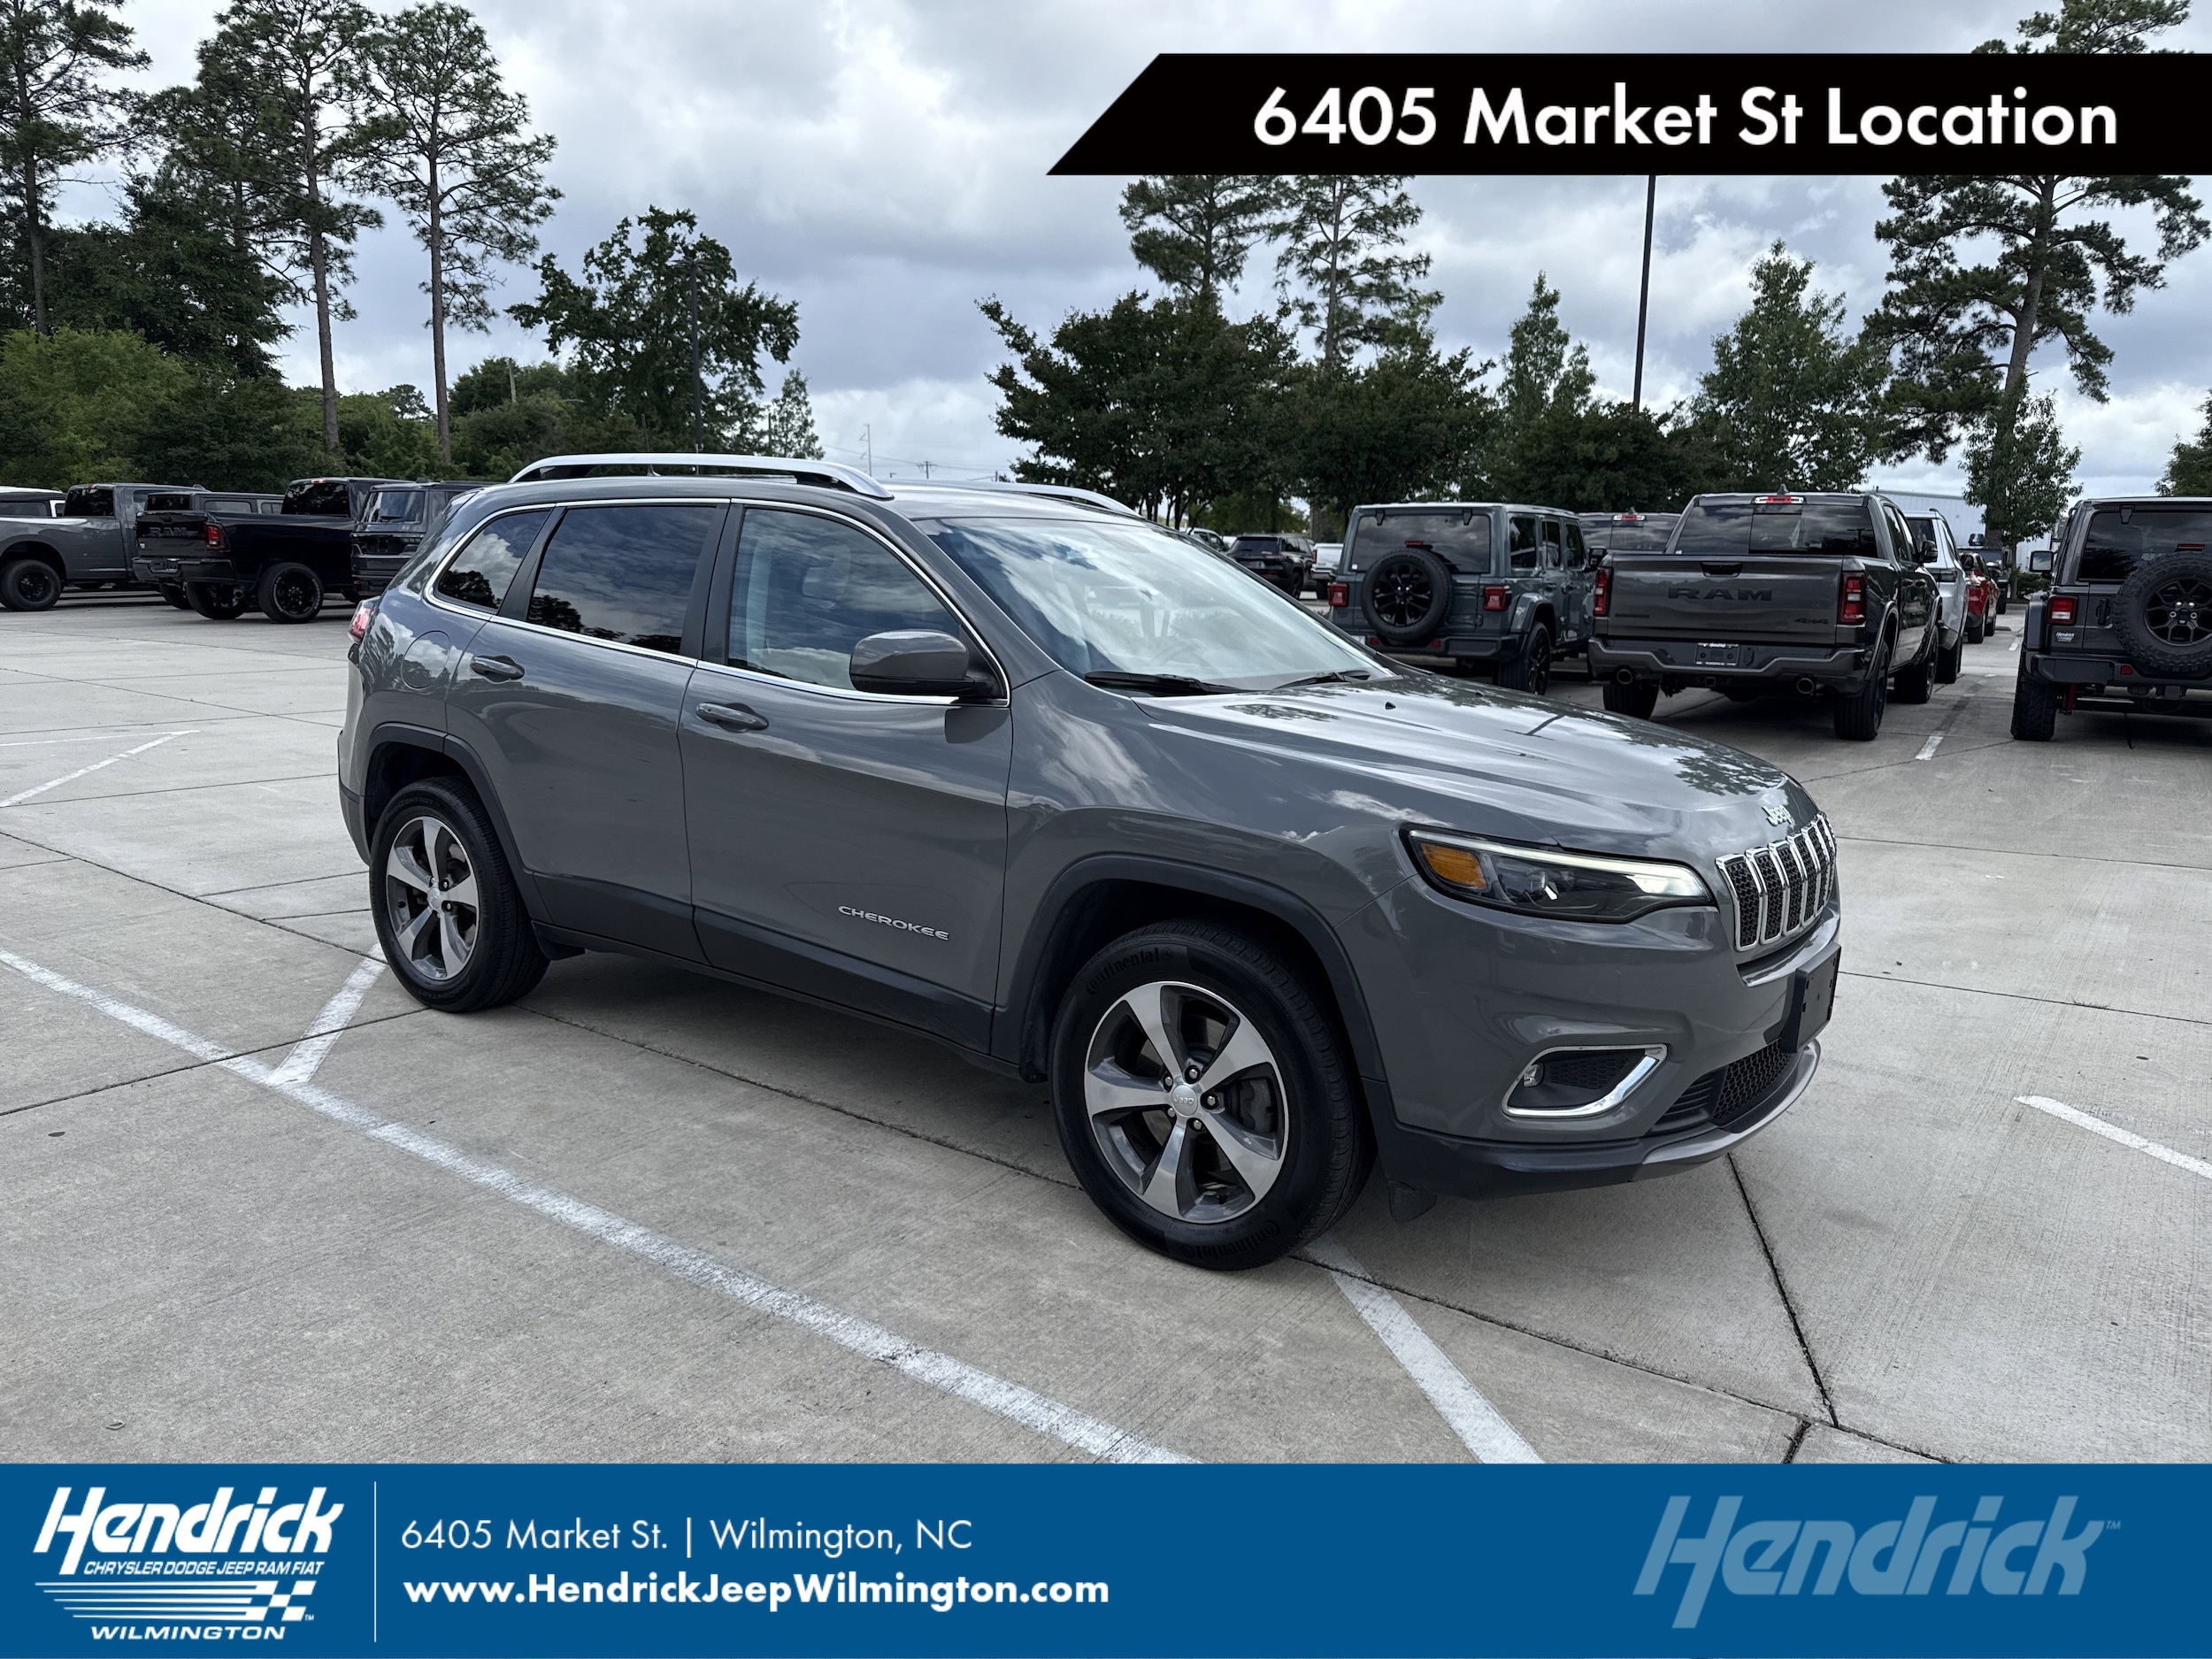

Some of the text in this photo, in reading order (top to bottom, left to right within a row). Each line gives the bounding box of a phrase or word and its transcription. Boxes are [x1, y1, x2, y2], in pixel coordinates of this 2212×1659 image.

[1668, 587, 1773, 602] RAM
[1761, 803, 1793, 826] Jeep
[838, 905, 949, 941] CHEROKEE
[1173, 1094, 1194, 1106] Jeep
